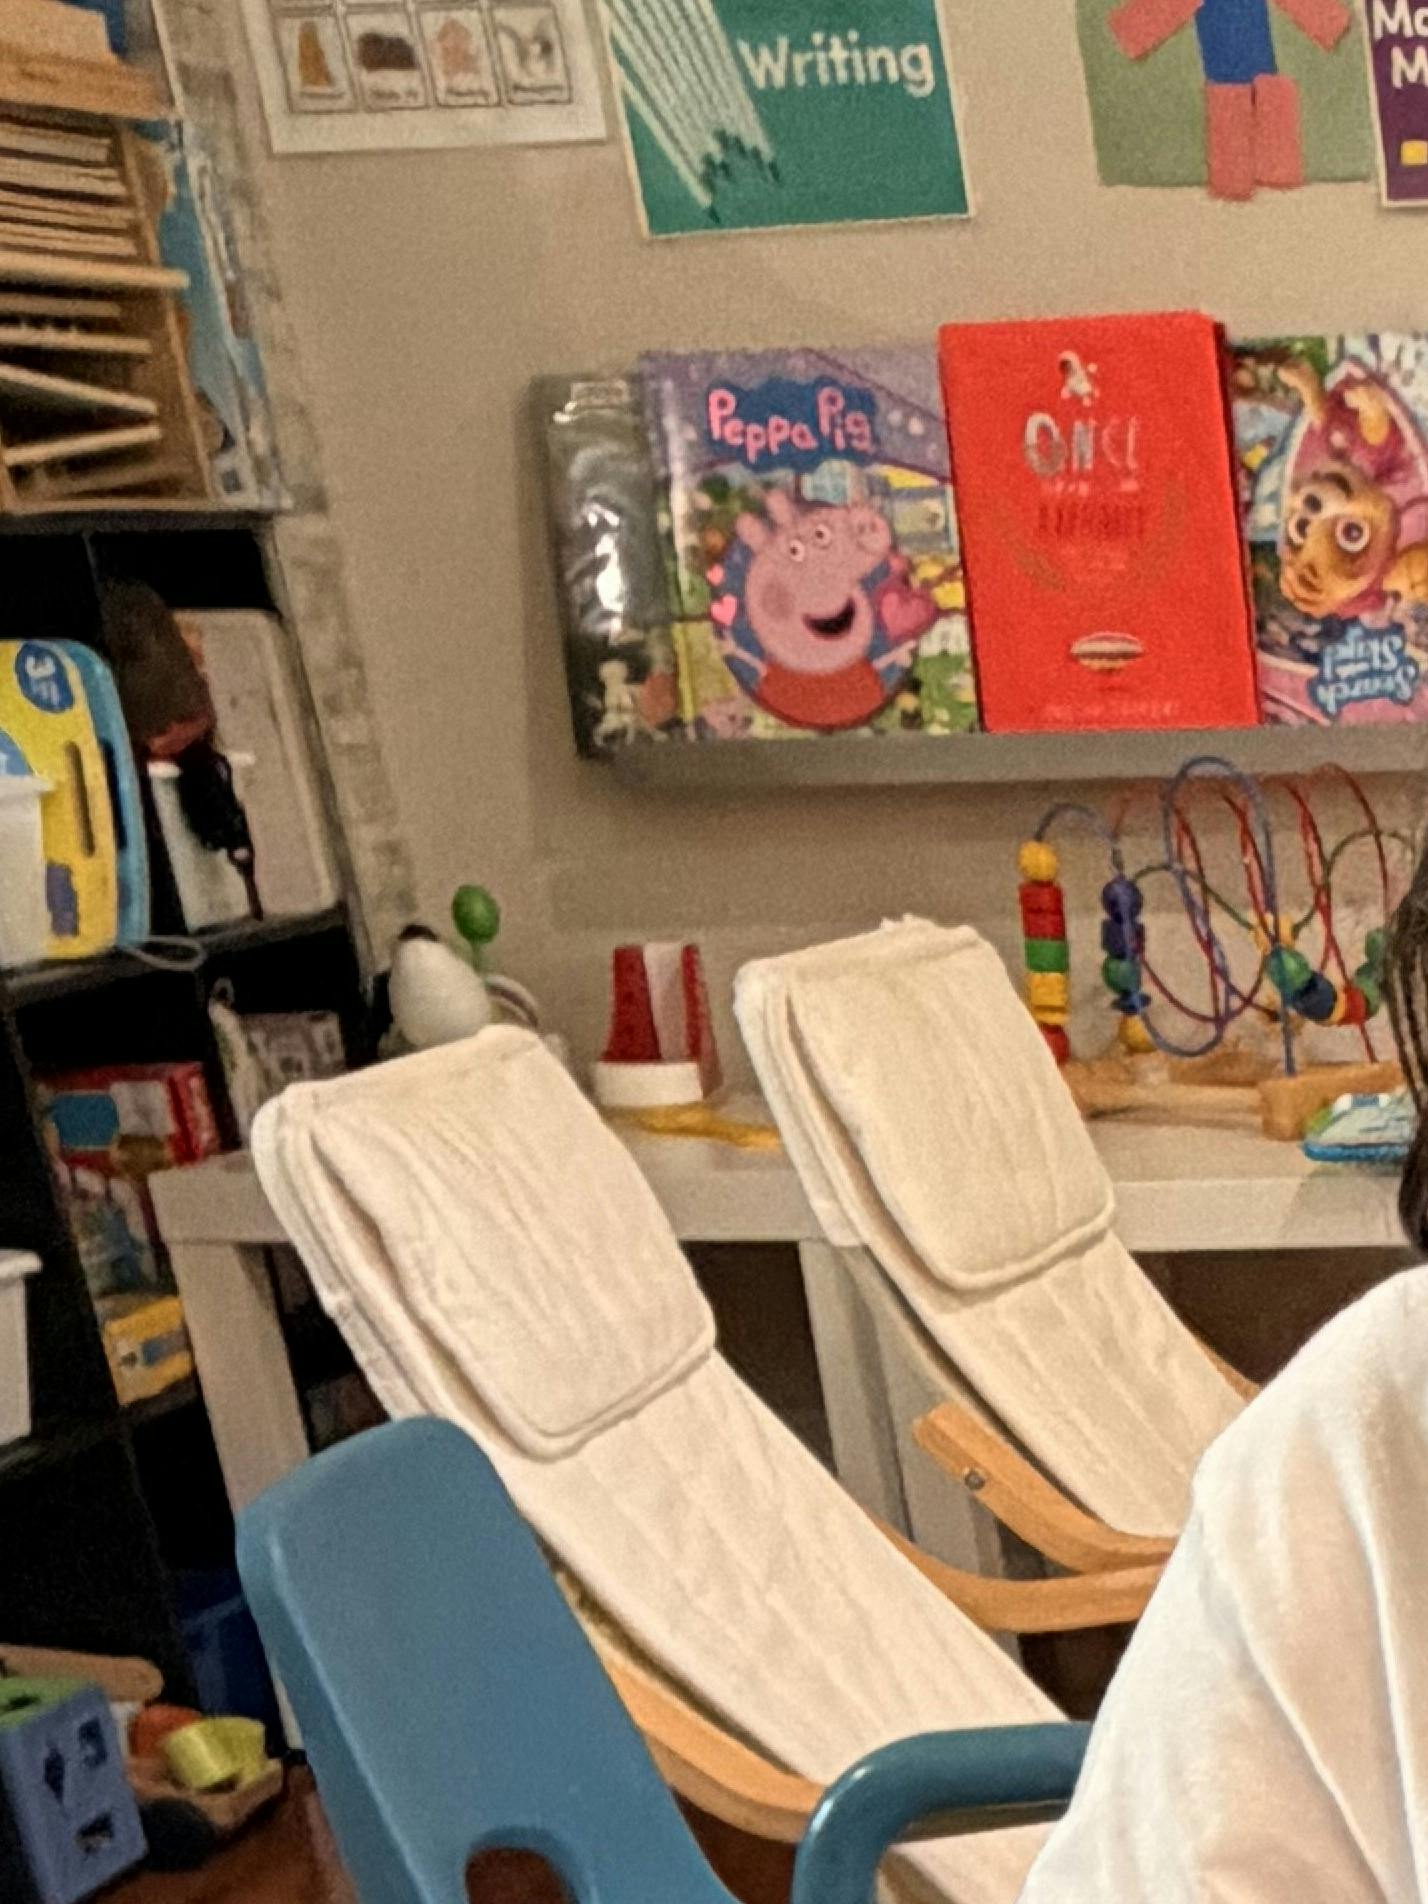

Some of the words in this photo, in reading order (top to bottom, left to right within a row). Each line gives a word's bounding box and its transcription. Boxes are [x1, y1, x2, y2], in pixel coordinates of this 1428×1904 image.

[737, 29, 935, 97] Writing
[709, 388, 818, 463] Peppa
[817, 386, 875, 453] Pig
